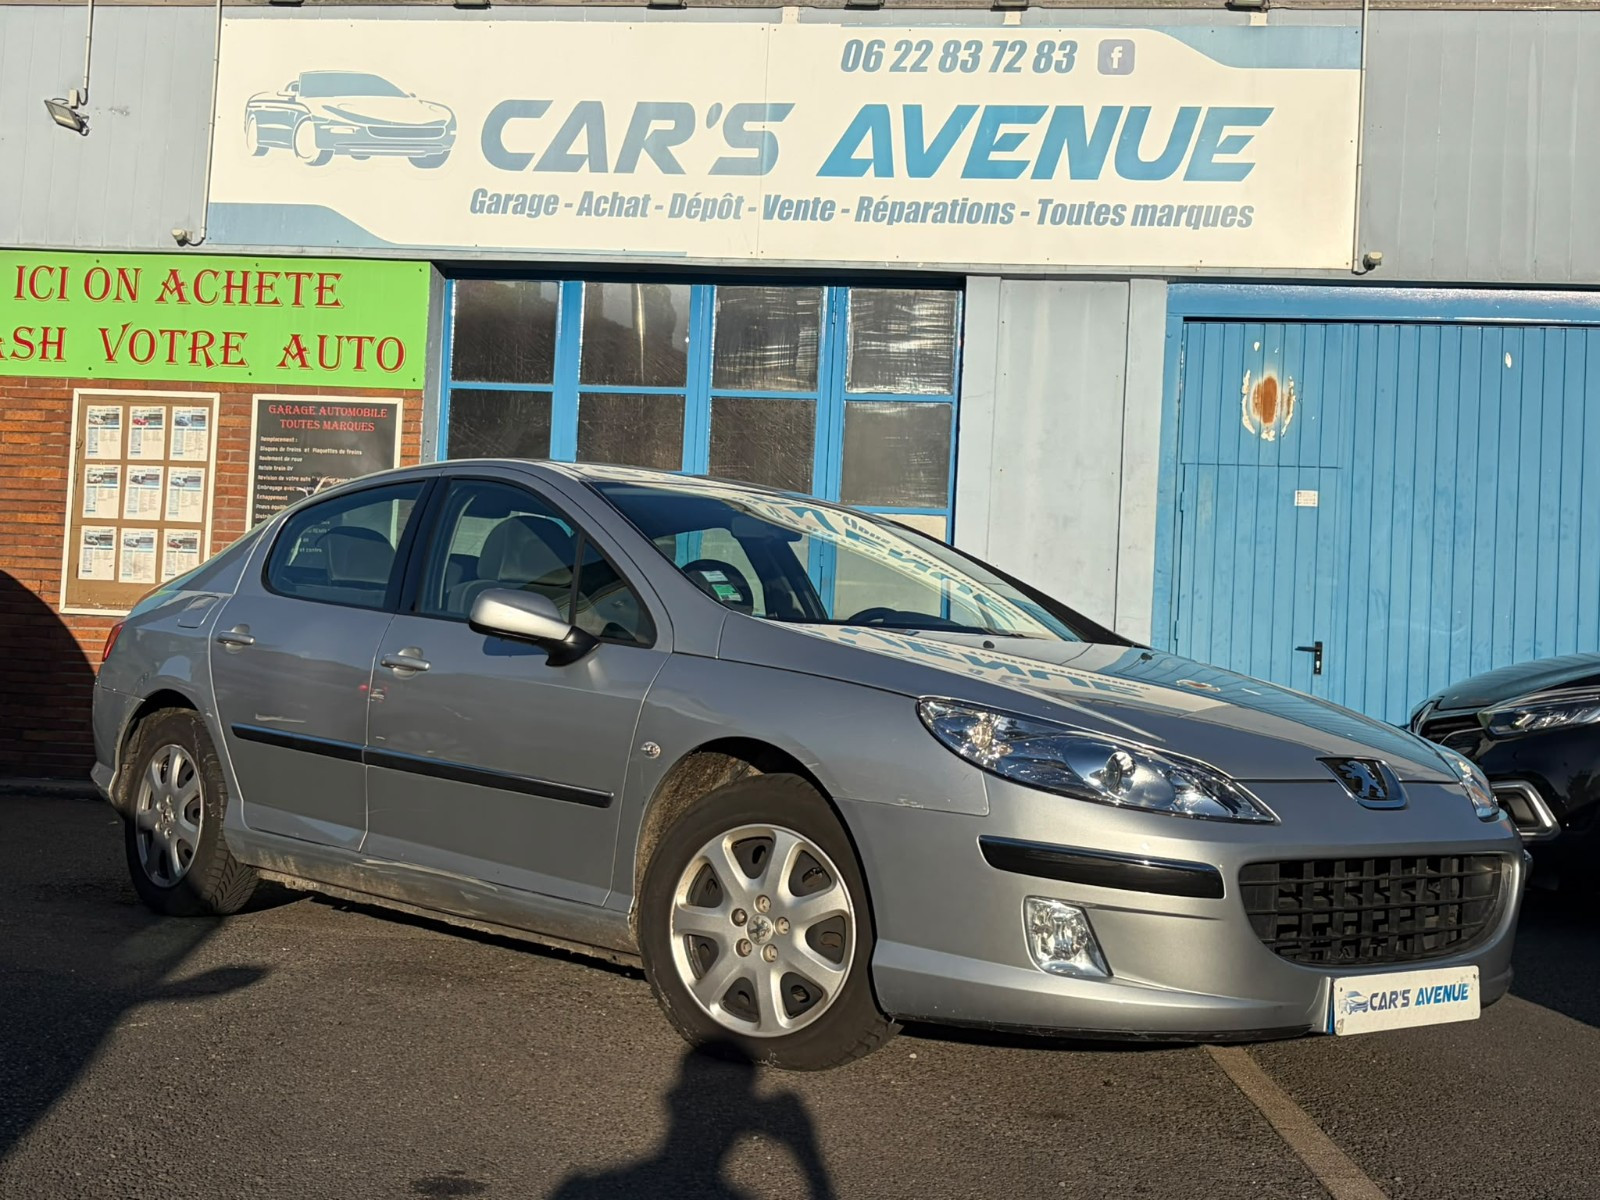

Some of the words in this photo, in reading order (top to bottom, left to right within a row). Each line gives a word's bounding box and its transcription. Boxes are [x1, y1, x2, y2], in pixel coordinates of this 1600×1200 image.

[840, 38, 886, 73] 06
[889, 39, 934, 73] 22
[938, 39, 983, 74] 83
[988, 40, 1029, 74] 72
[1032, 39, 1078, 74] 83
[480, 99, 795, 176] CAR'S
[816, 104, 1275, 182] AVENUE
[469, 187, 558, 218] Garage
[577, 190, 650, 218] Achat
[668, 191, 744, 222] Dépôt
[763, 194, 836, 222] Vente
[855, 196, 1015, 226] Réparations
[1037, 199, 1127, 227] Toutes
[1131, 204, 1254, 231] marques
[14, 265, 69, 301] ICI
[84, 267, 142, 303] ON
[155, 269, 344, 308] ACHETE
[0, 326, 67, 362] SH
[99, 322, 248, 369] VOTRE
[277, 334, 407, 373] AUTO
[268, 404, 316, 416] GARAGE
[319, 406, 388, 418] AUTOMOBILE
[280, 419, 320, 430] TOUTES
[322, 421, 375, 432] MARQUES
[1369, 988, 1411, 1011] CAR'S
[1414, 983, 1470, 1006] AVENUE
